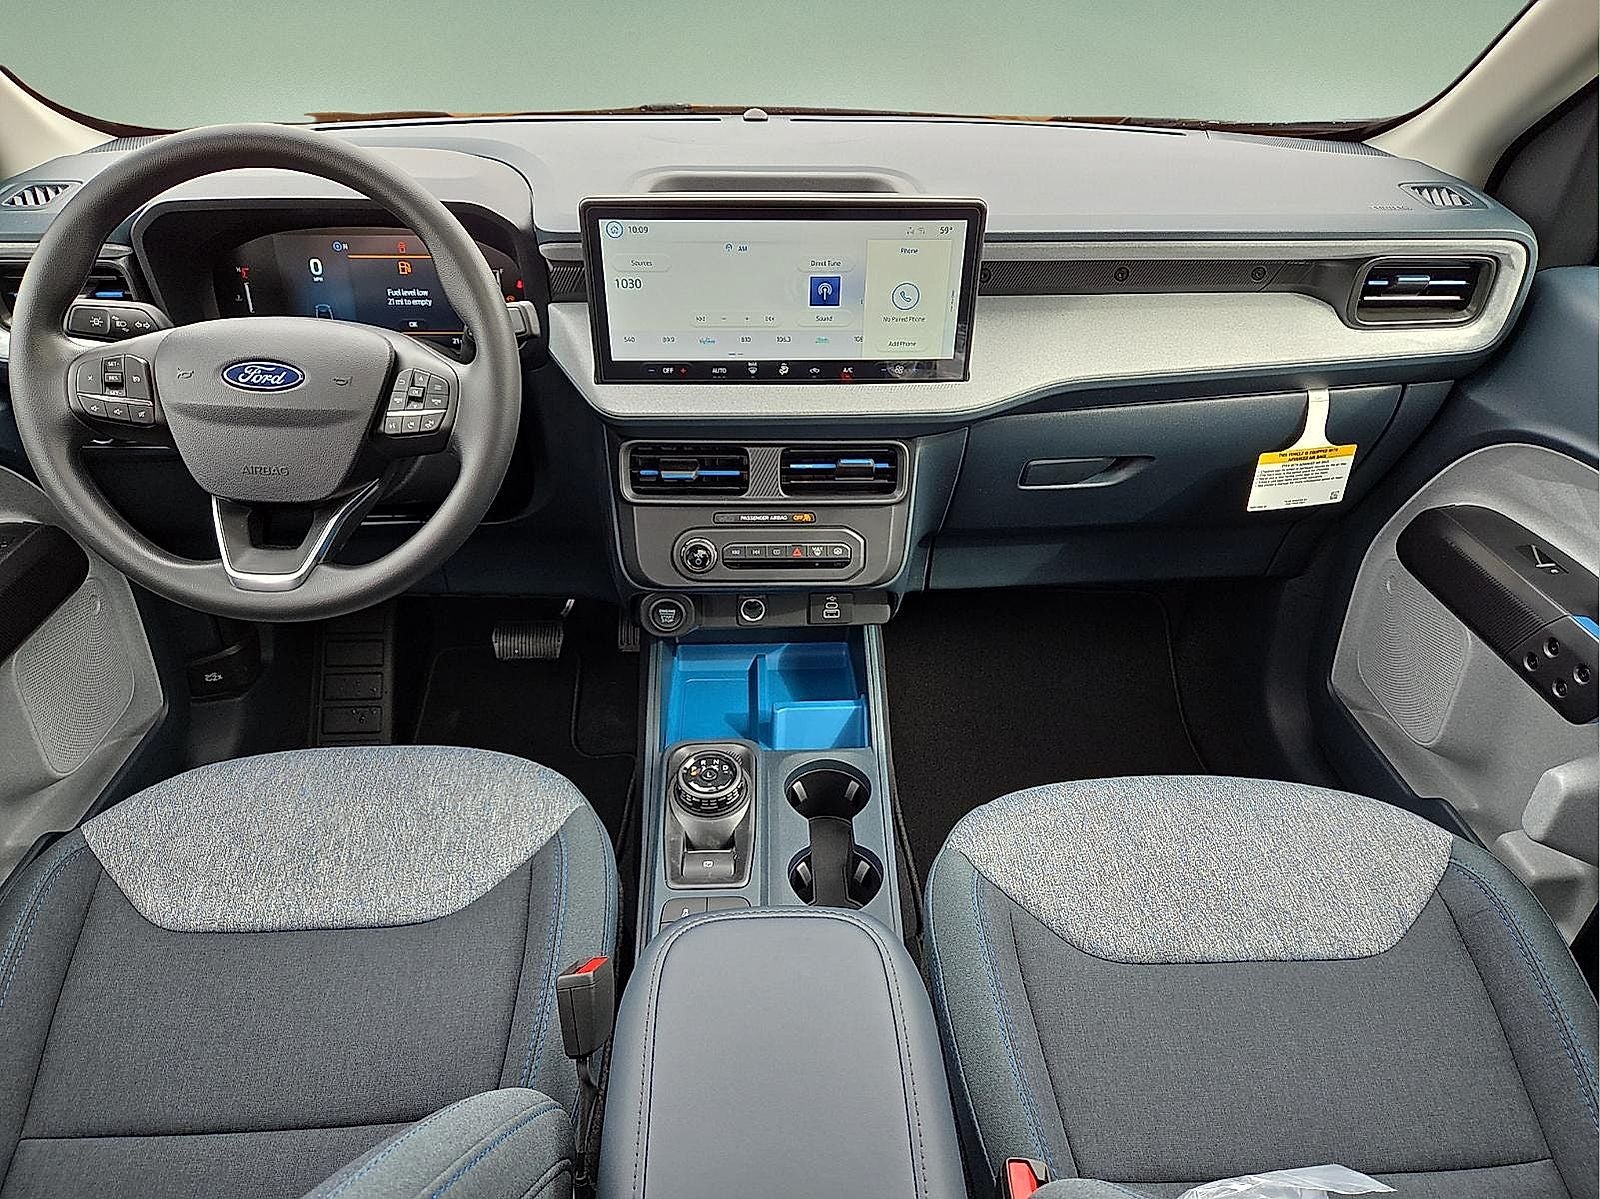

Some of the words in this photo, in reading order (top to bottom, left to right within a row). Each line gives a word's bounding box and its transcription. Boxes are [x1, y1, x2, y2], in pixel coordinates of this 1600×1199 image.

[628, 225, 649, 234] 10:09
[309, 258, 324, 276] 0
[615, 278, 642, 289] 1030
[387, 288, 401, 297] Fuel
[401, 288, 416, 297] level
[416, 288, 429, 297] low
[387, 298, 395, 306] 21
[412, 298, 433, 307] empty
[238, 365, 287, 385] Ford
[241, 464, 290, 477] AIRBAG
